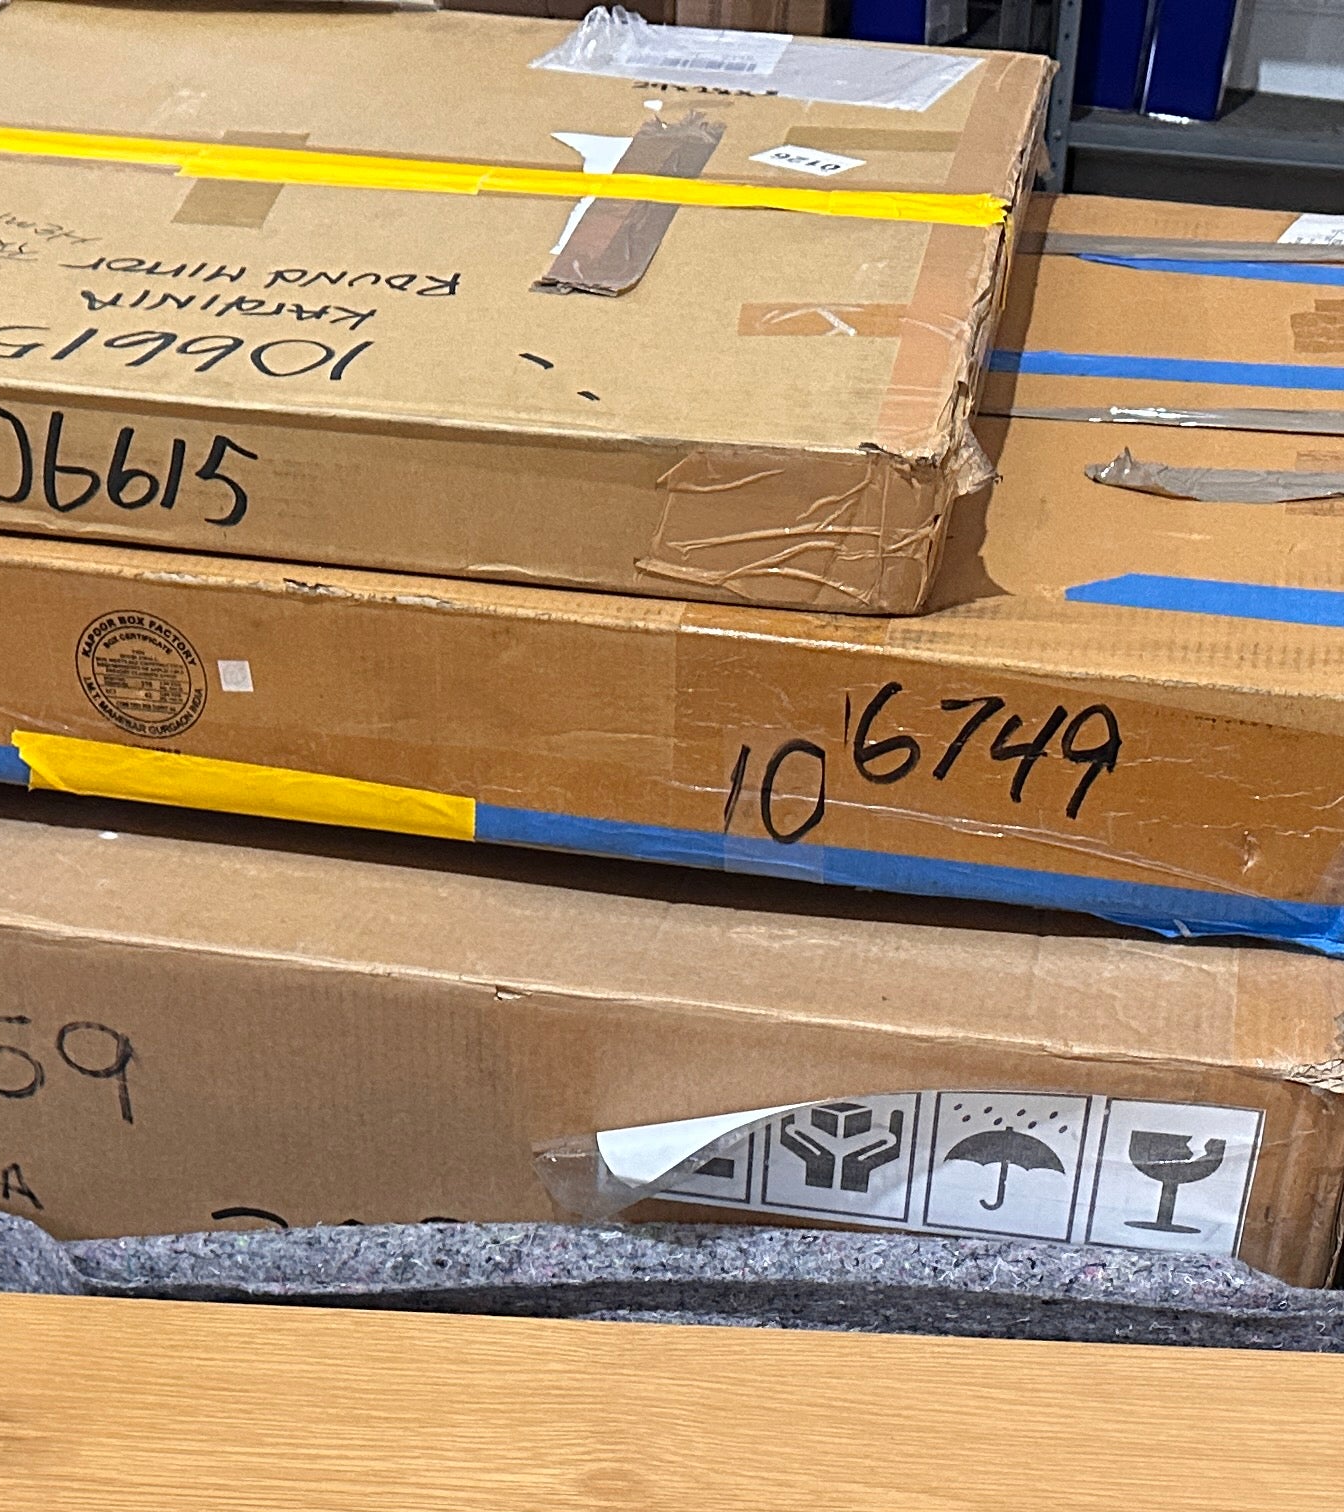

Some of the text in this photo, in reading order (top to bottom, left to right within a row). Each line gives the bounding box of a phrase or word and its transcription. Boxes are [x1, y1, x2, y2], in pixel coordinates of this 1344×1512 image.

[81, 618, 117, 658] KAPOOR
[117, 616, 145, 627] BOX
[148, 620, 198, 667] FACTORY
[119, 632, 174, 656] CERTIFICATE
